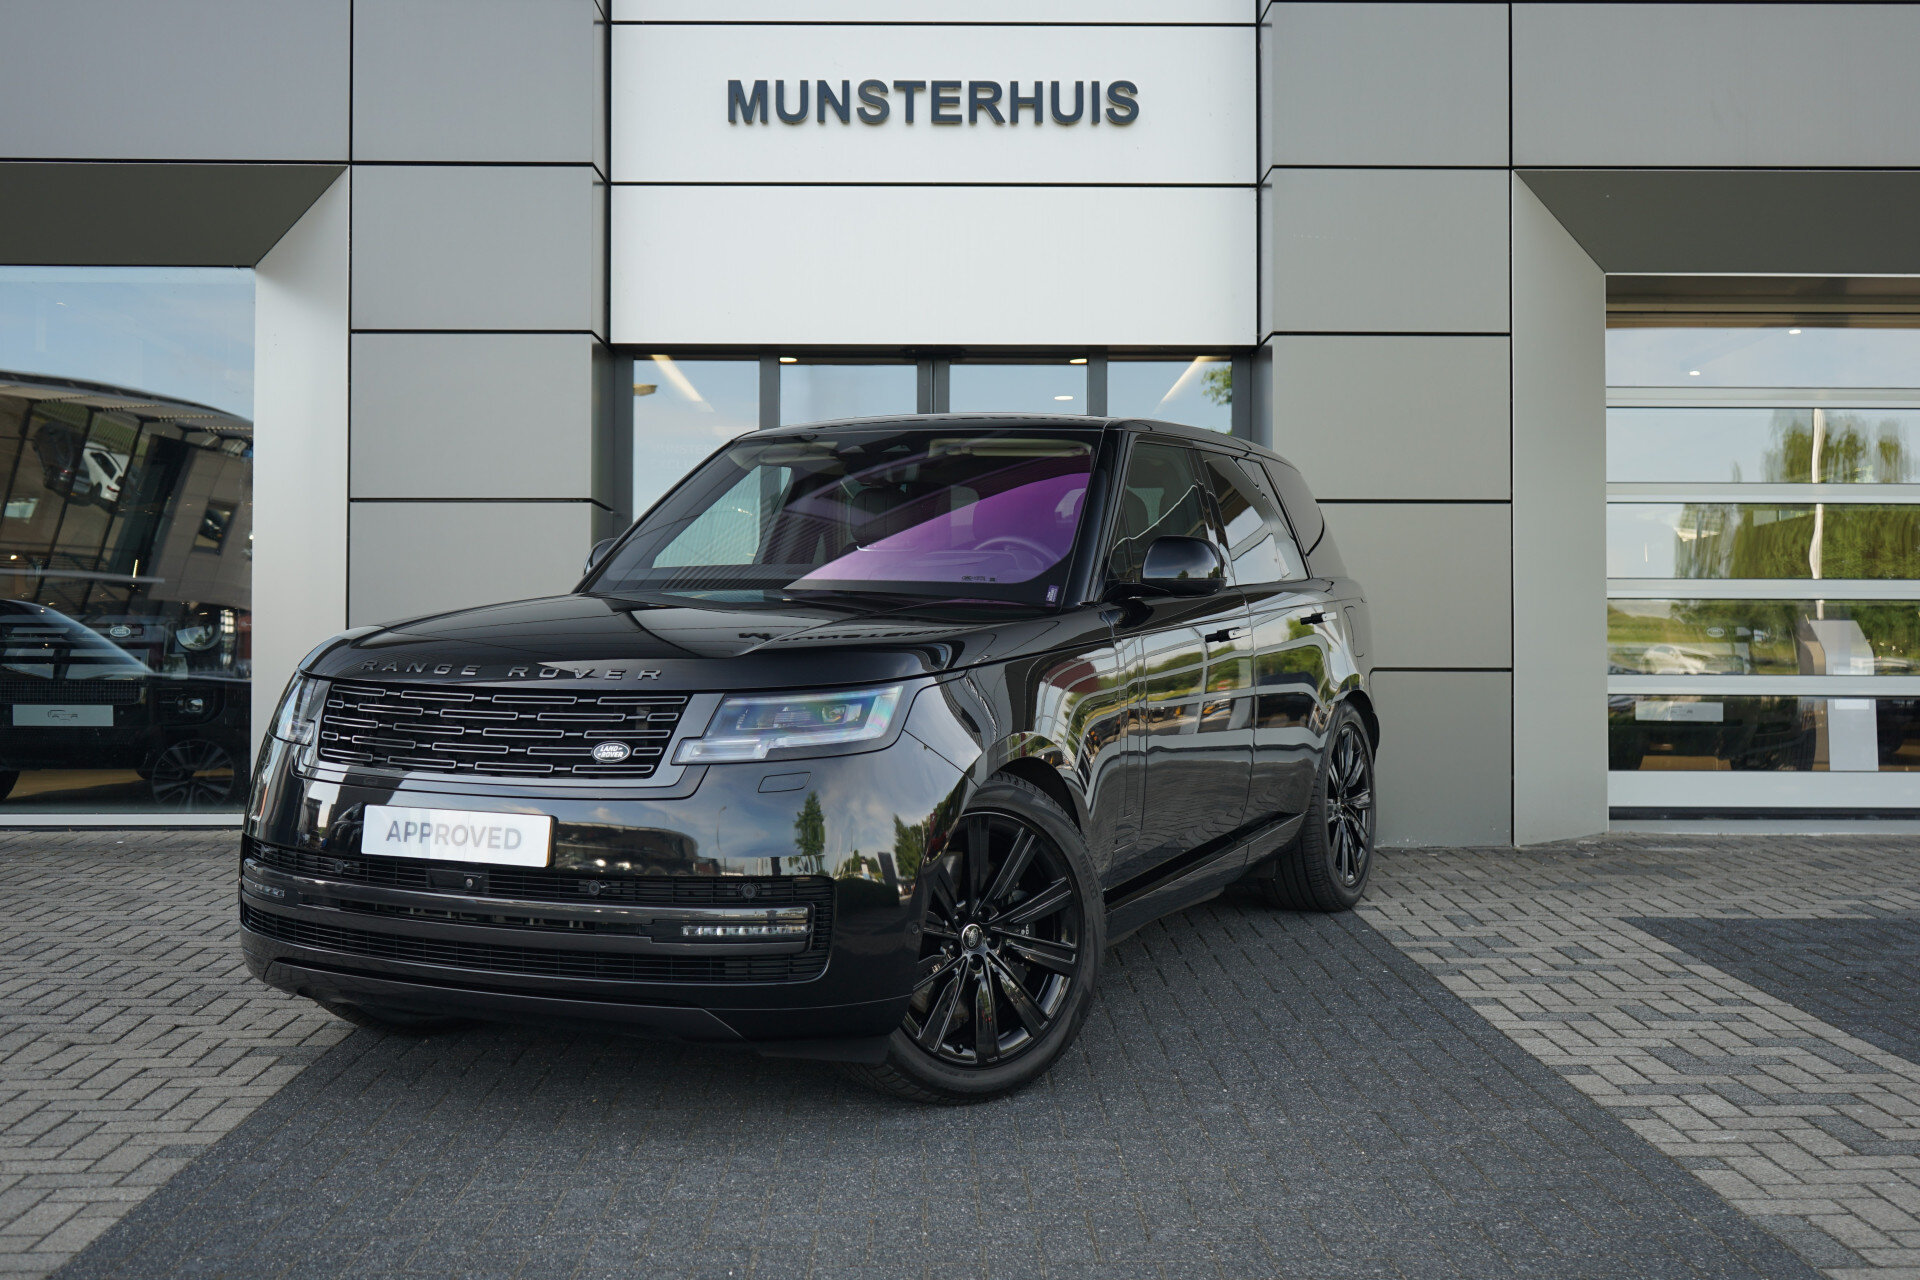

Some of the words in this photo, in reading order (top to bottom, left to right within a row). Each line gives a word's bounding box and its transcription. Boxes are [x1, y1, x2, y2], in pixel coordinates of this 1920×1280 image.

[727, 79, 1140, 125] MUNSTERHUIS
[360, 660, 482, 677] RANGE
[507, 665, 664, 681] ROVER
[385, 820, 523, 850] APPROVED
